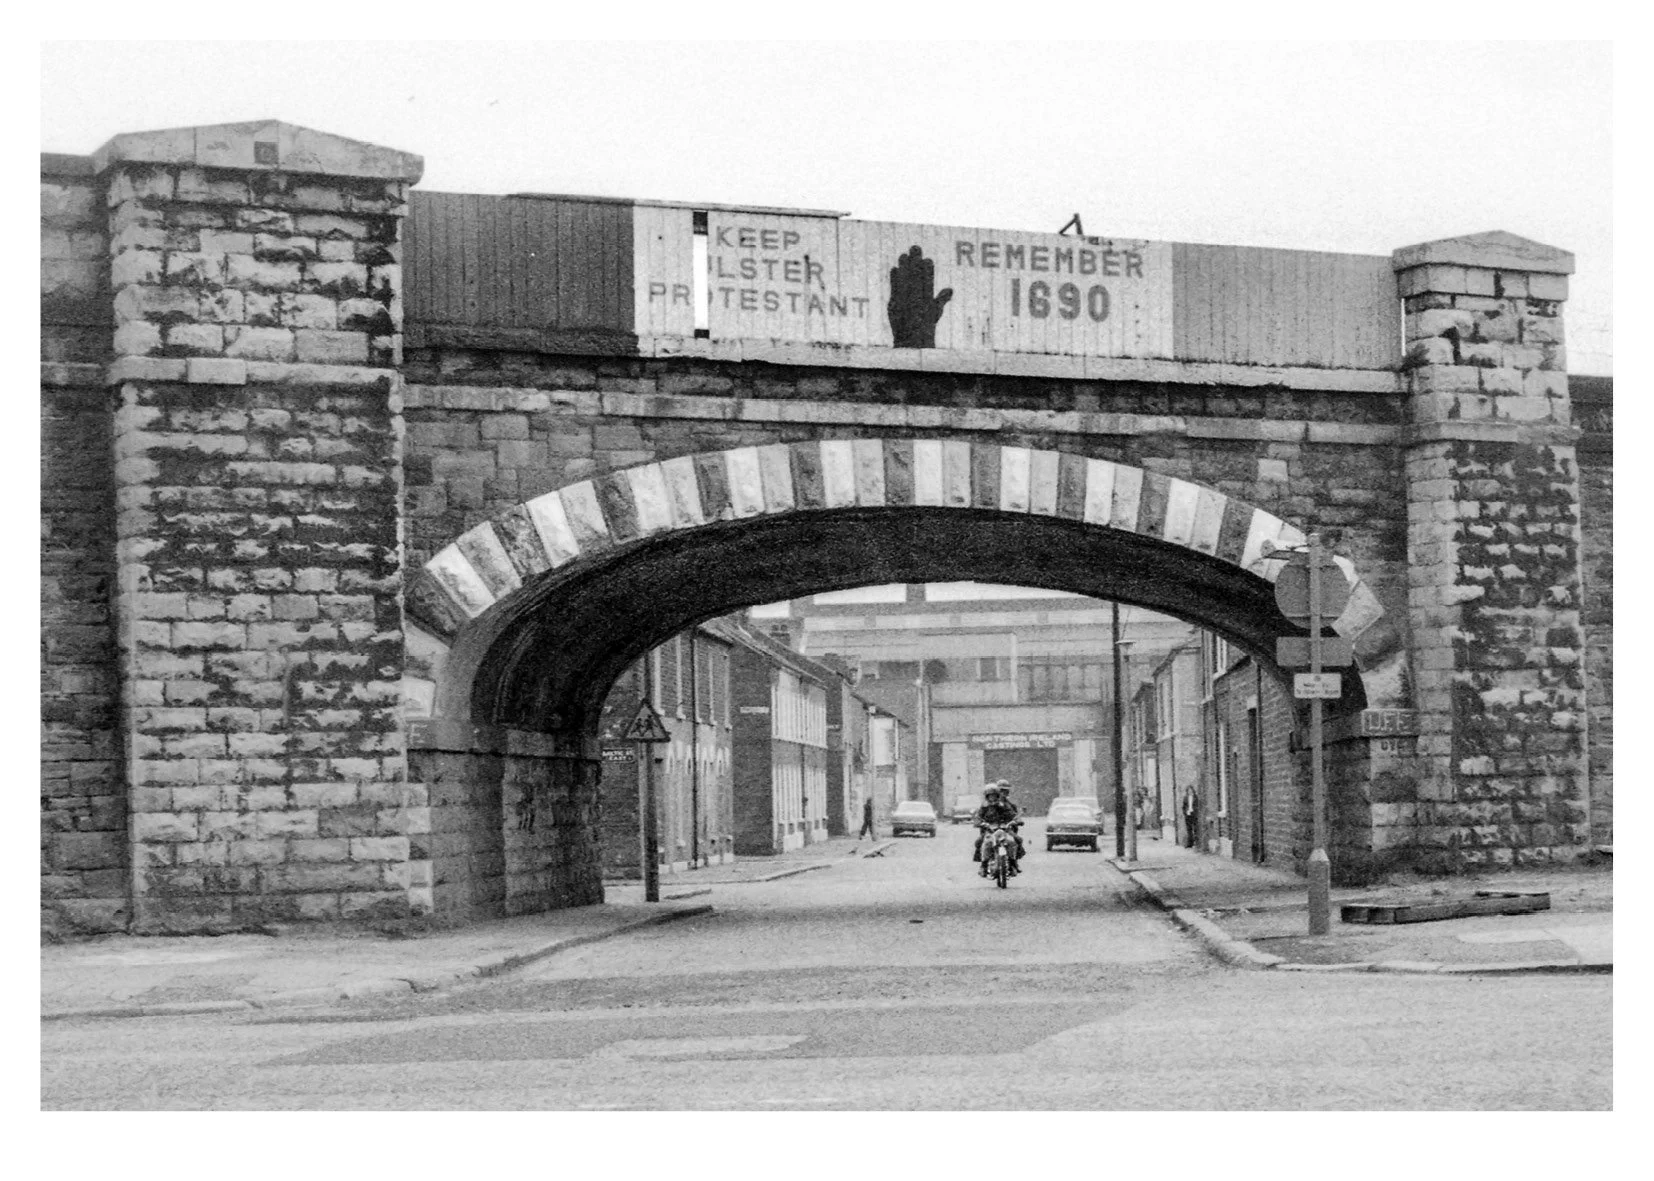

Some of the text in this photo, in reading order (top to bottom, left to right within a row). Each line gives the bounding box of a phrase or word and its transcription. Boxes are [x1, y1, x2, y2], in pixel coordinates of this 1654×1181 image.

[716, 226, 800, 250] KEEP
[955, 241, 1143, 278] REMEMBER
[650, 282, 869, 318] PRTESTANT
[1011, 278, 1110, 323] 1690
